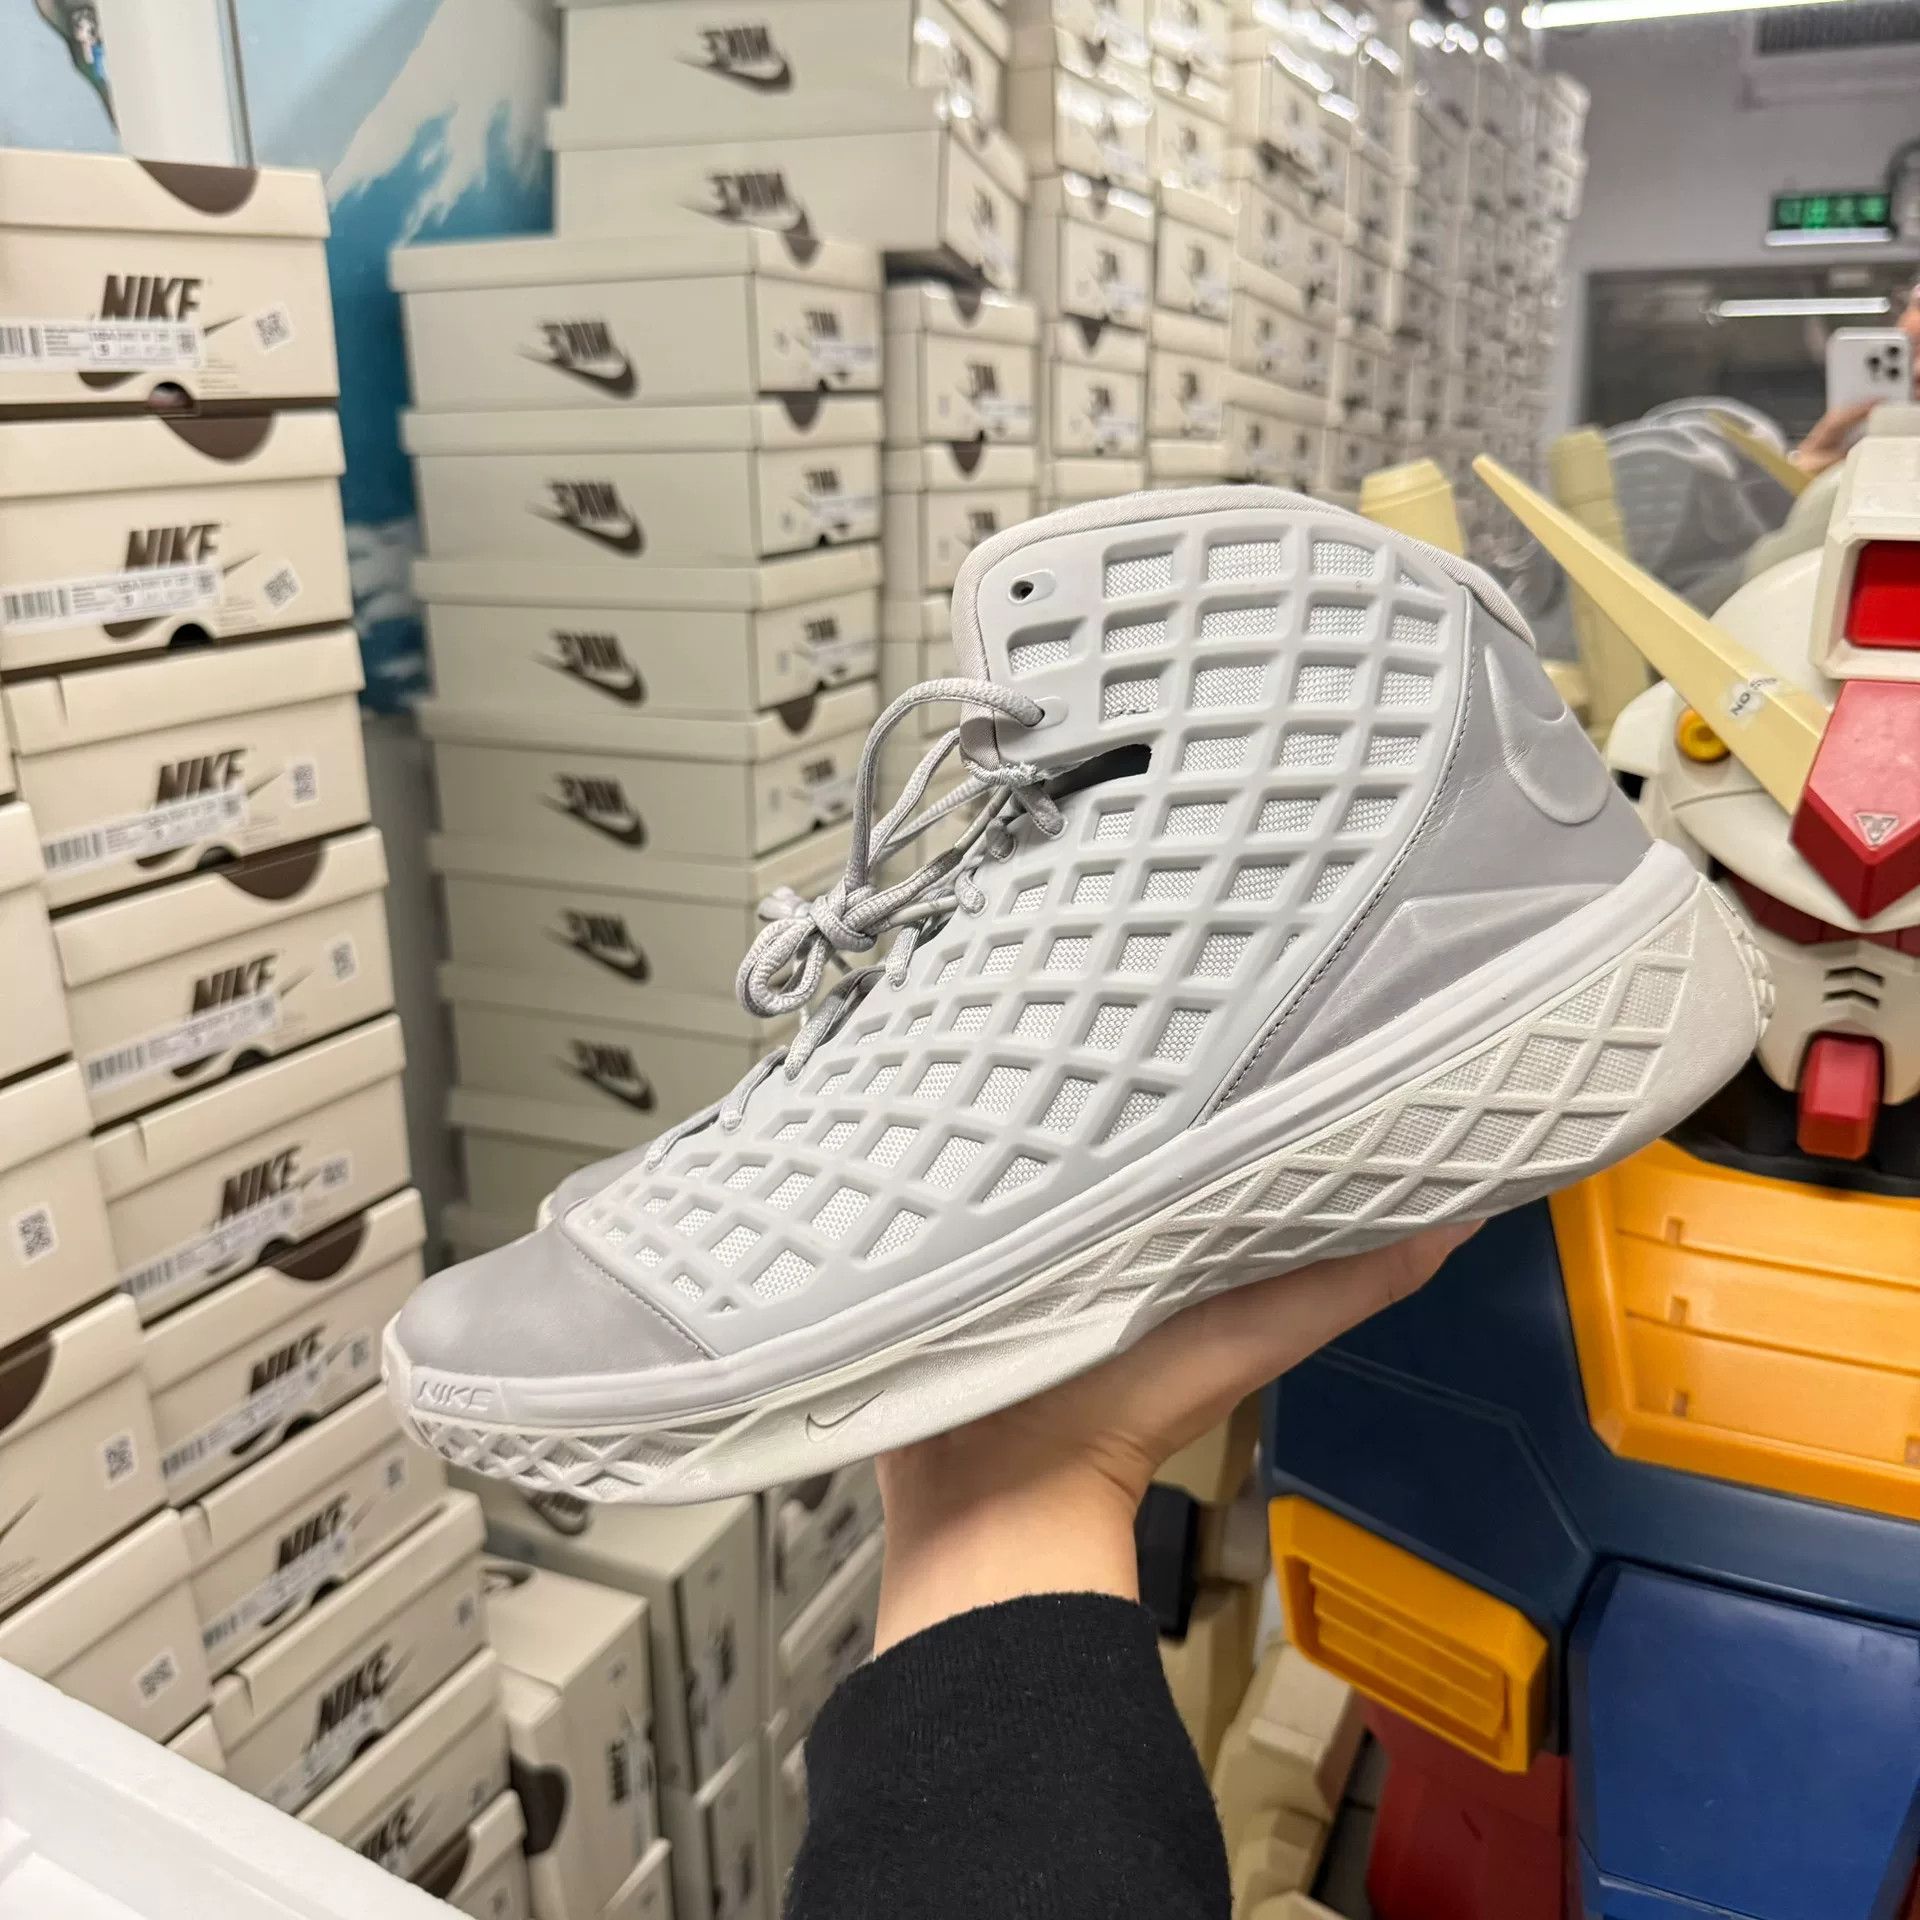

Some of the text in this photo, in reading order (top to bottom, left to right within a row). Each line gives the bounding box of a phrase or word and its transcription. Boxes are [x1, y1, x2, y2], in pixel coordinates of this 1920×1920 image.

[101, 274, 203, 321] NIKE
[125, 523, 222, 569] NIKE
[1730, 691, 1751, 716] NO
[156, 748, 248, 804] NIKE
[192, 954, 278, 1014] NIKE
[221, 1145, 301, 1221] NIKE
[416, 1380, 494, 1411] NIKE
